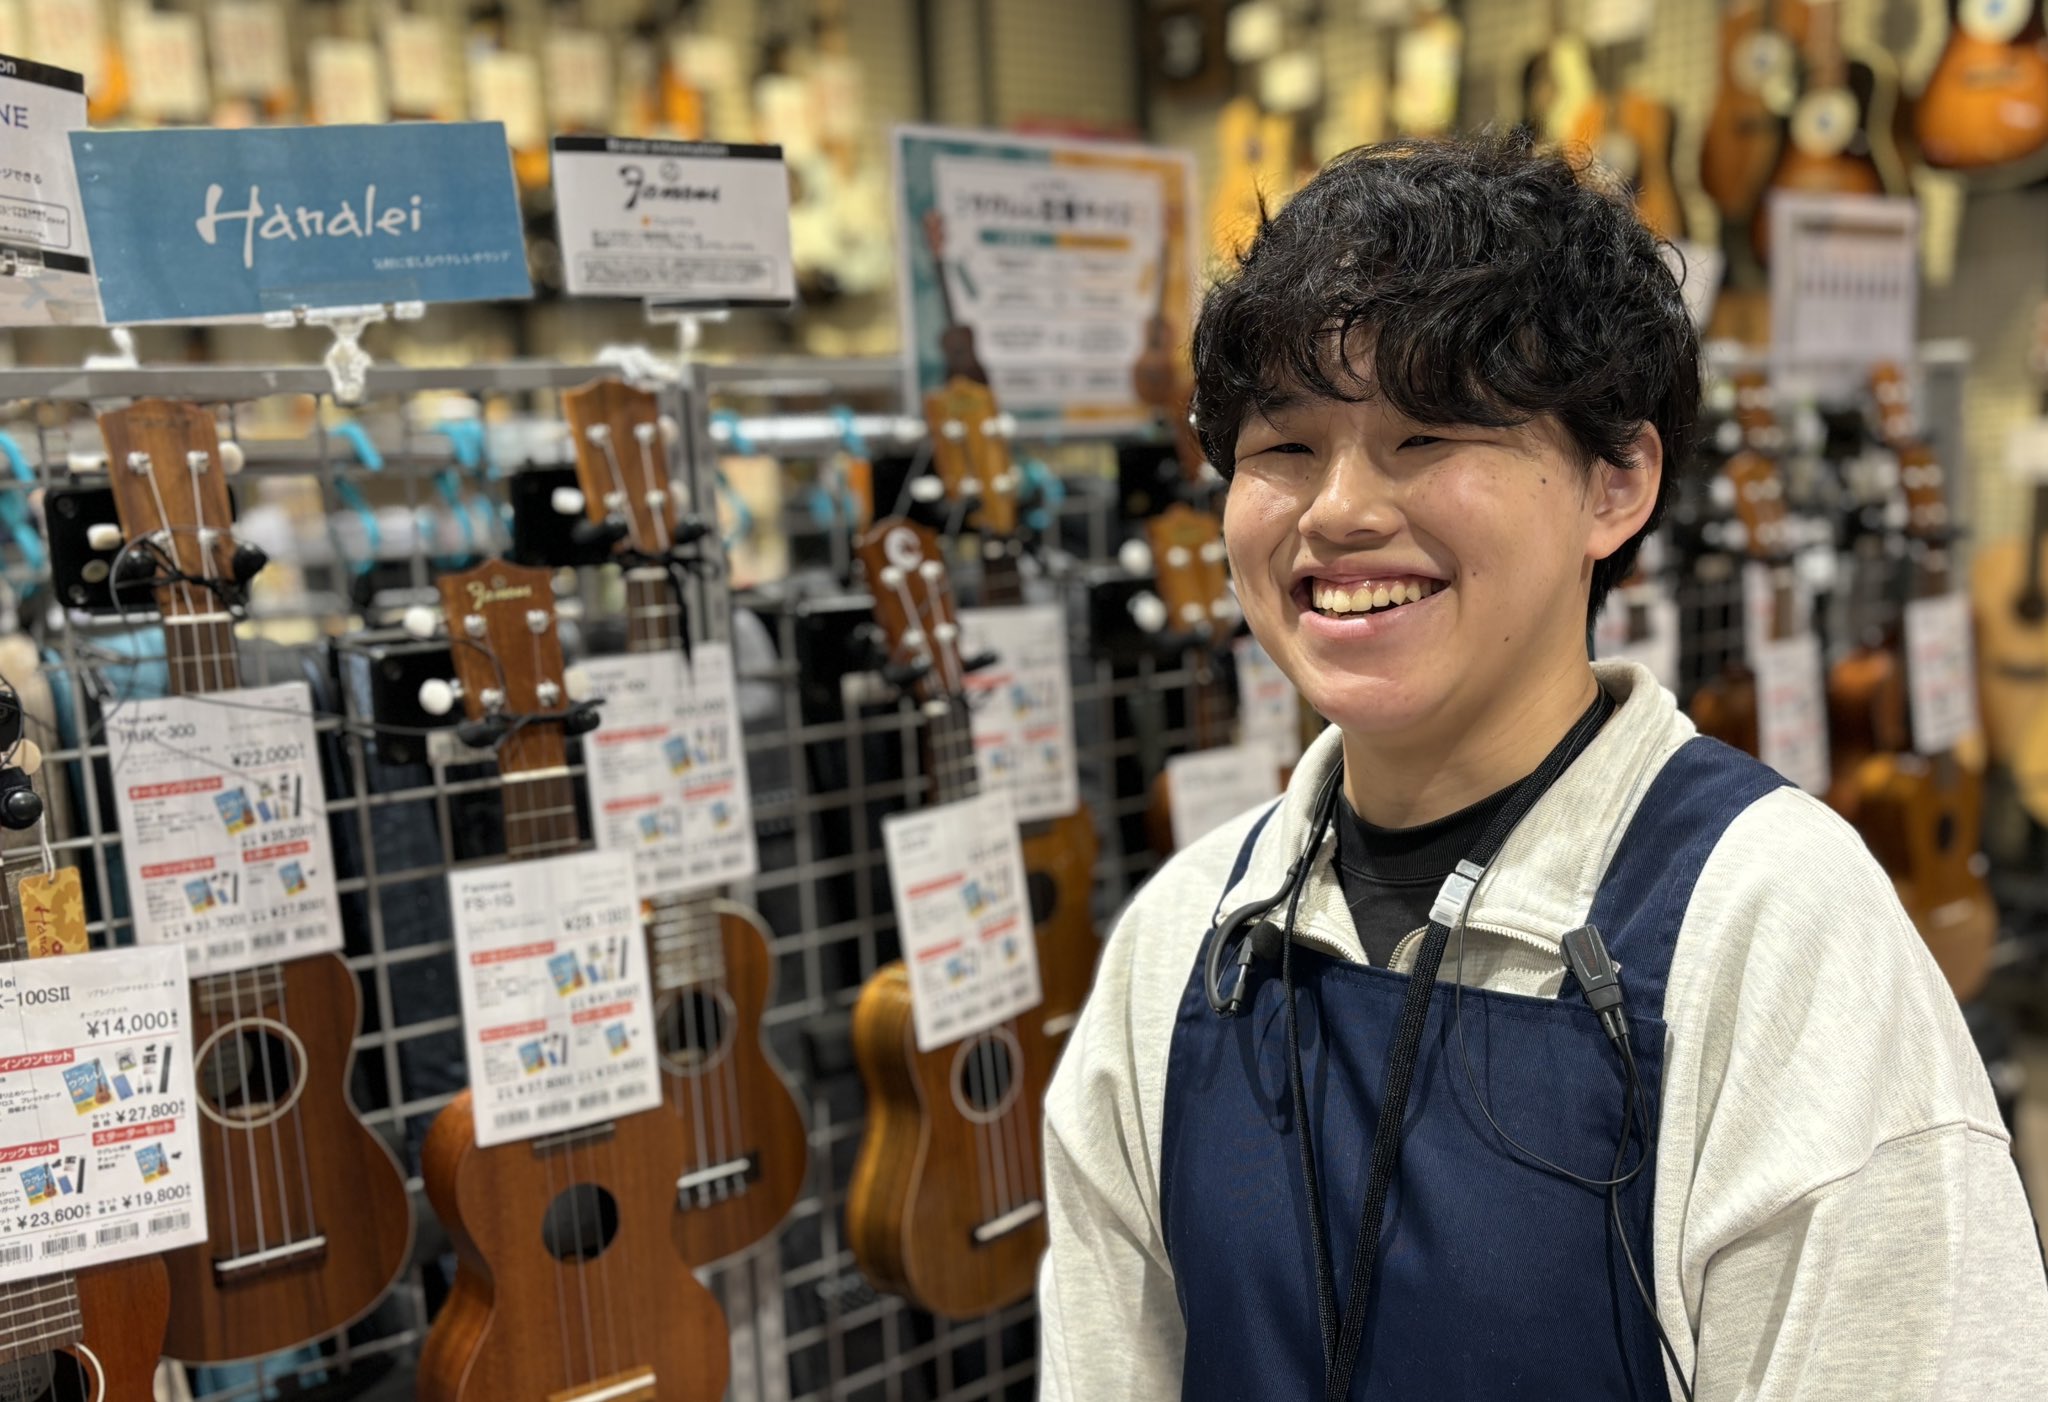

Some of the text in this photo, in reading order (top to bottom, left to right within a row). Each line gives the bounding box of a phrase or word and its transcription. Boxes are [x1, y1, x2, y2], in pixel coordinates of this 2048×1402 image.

[196, 184, 422, 268] Hanalei
[86, 1011, 169, 1038] ¥14,000
[115, 1101, 179, 1124] ¥27,800
[122, 1185, 186, 1209] ¥19,800
[16, 1204, 84, 1230] ¥23,600
